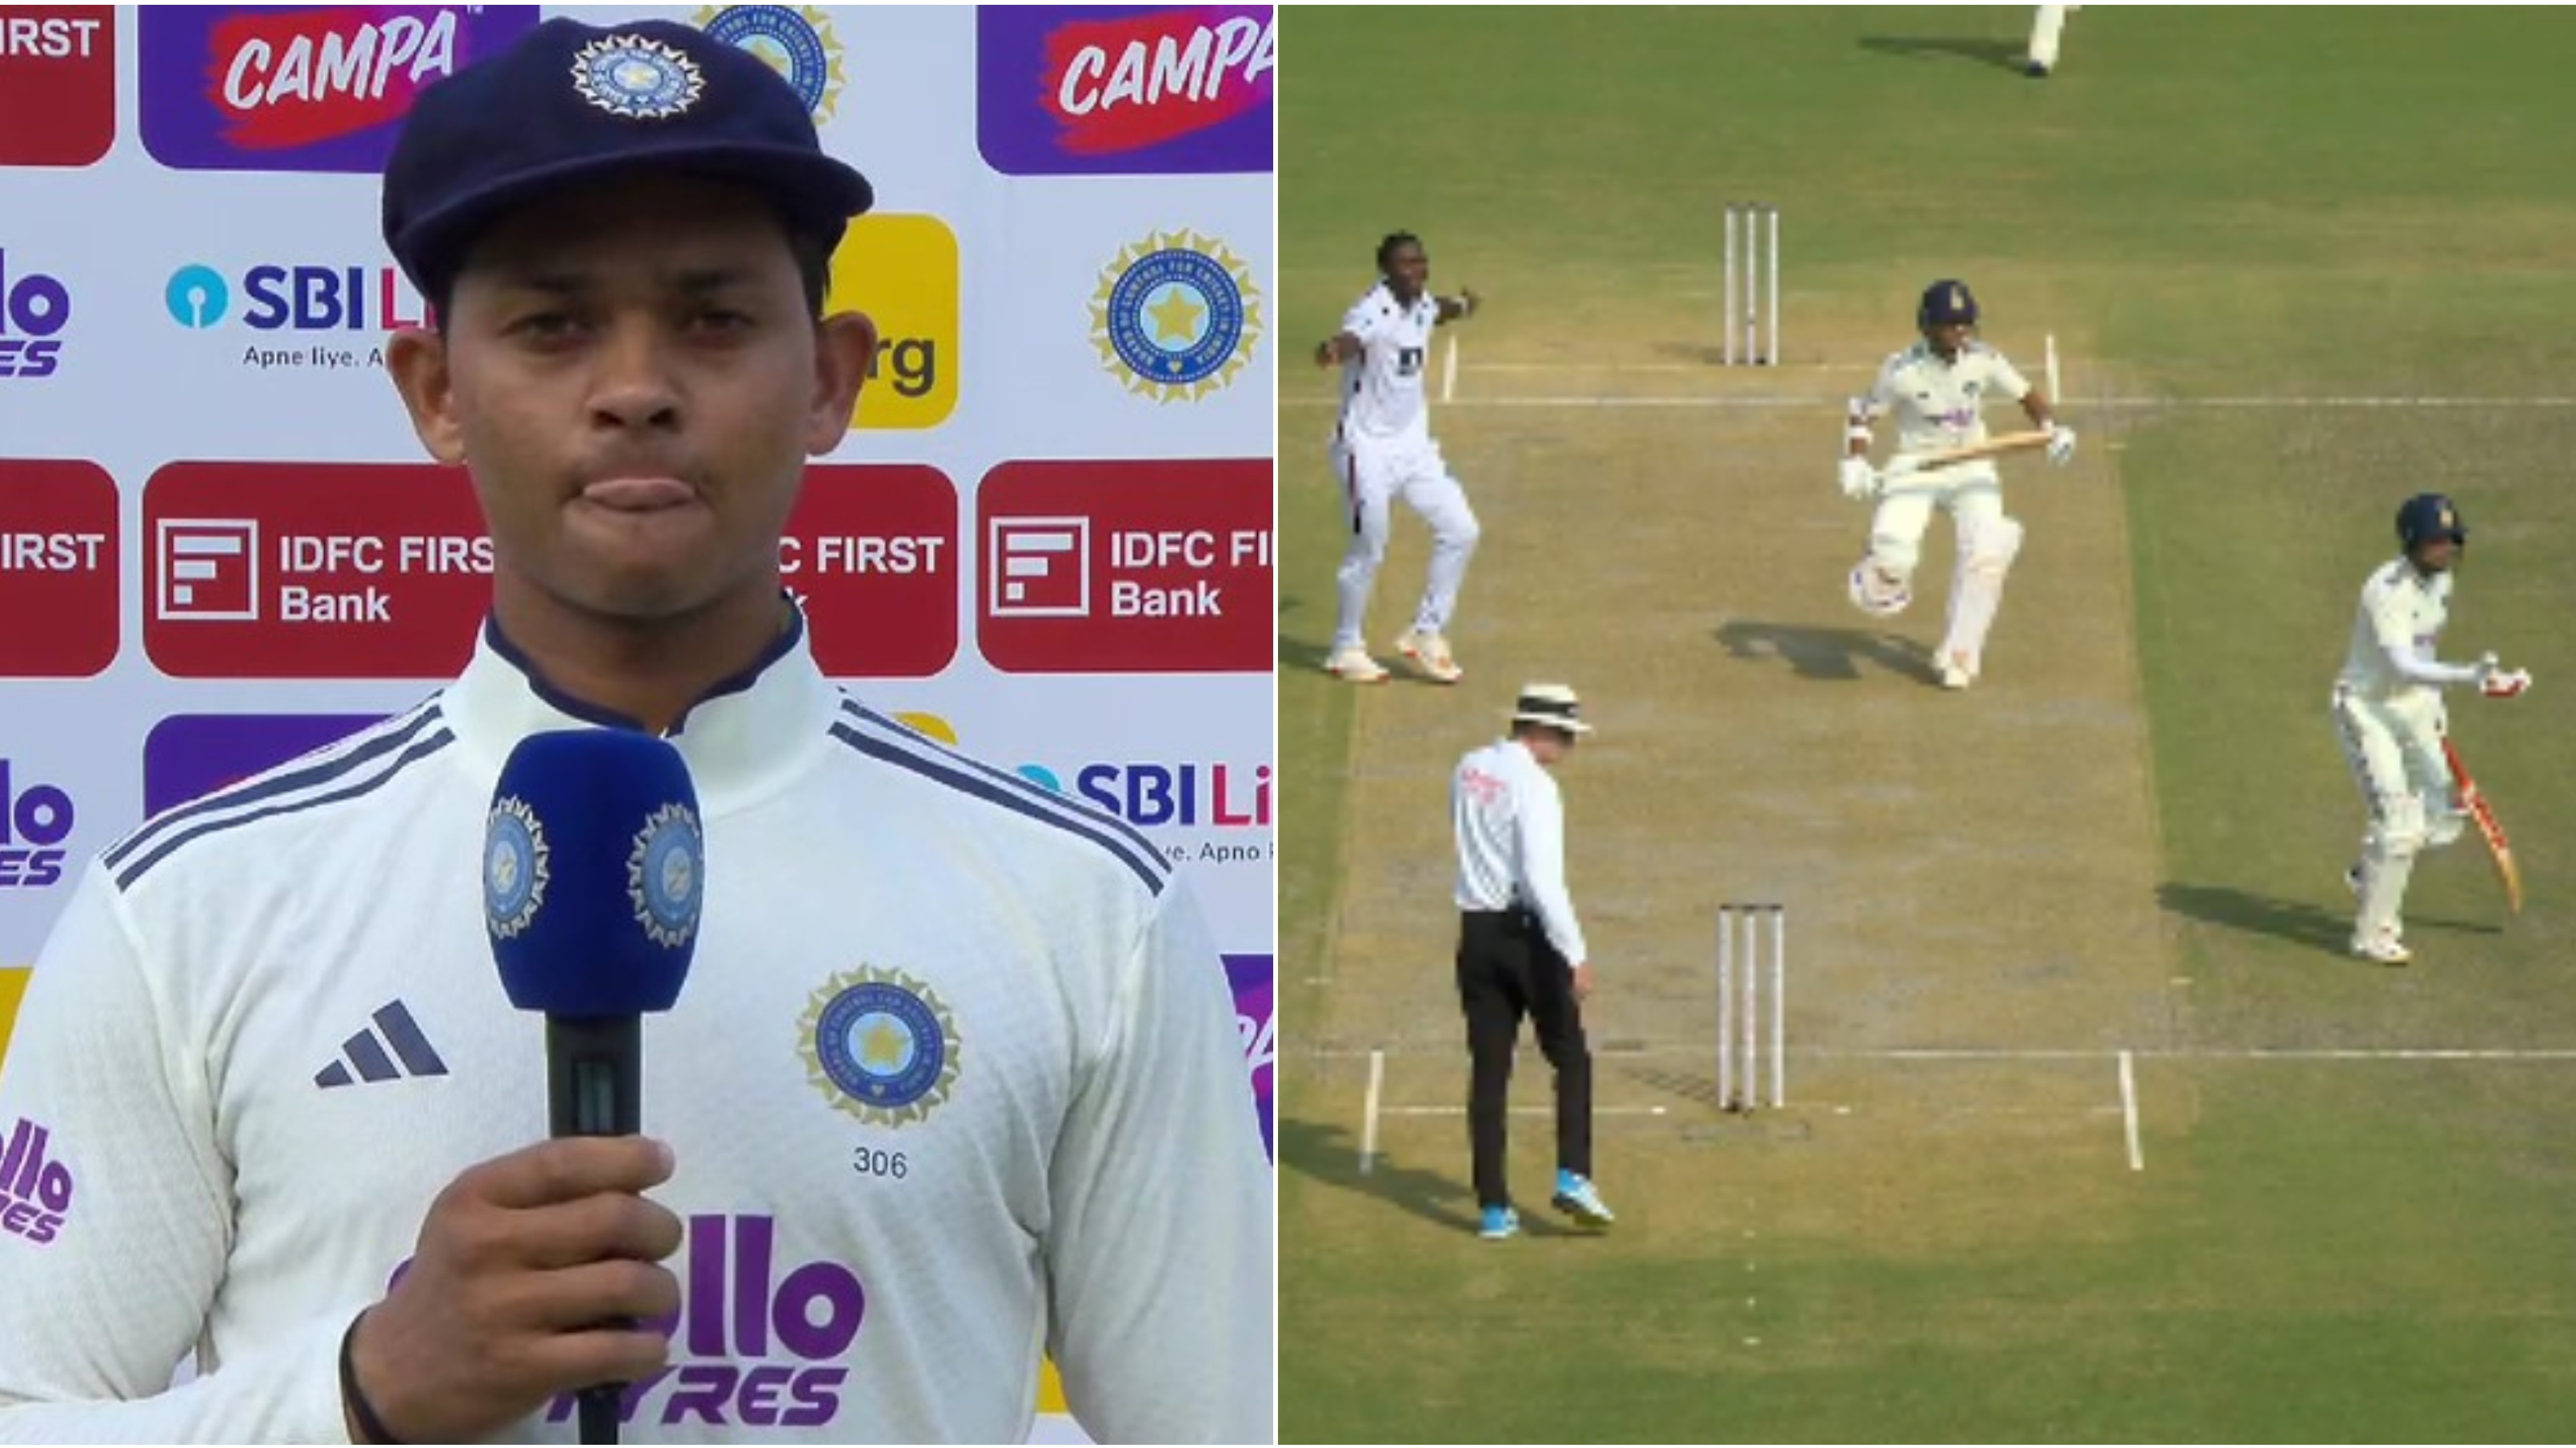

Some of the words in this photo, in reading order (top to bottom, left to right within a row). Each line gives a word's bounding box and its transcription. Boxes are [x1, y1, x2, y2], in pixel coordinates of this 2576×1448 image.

[223, 9, 457, 110] CAMPA
[242, 265, 363, 330] SBI
[242, 346, 304, 368] Apne
[281, 535, 384, 573] IDFC
[817, 536, 945, 574] FIRST
[1111, 530, 1215, 568] IDFC
[1230, 530, 1273, 567] FI
[281, 585, 391, 622] Bank
[1111, 580, 1222, 617] Bank
[1077, 764, 1196, 826] SBI
[1200, 842, 1260, 863] Apno
[0, 1118, 71, 1213] llo
[853, 1146, 907, 1179] 306
